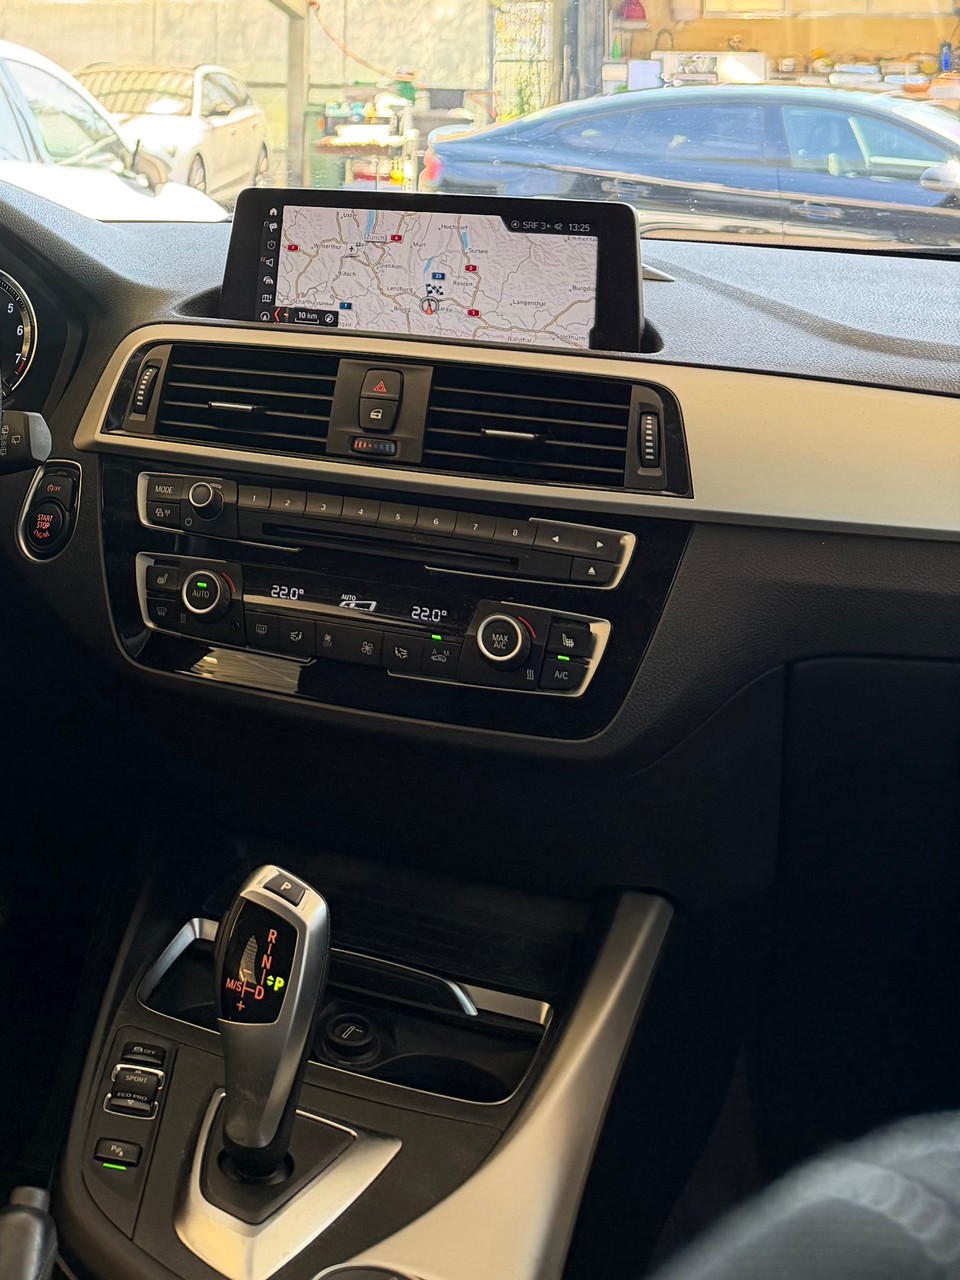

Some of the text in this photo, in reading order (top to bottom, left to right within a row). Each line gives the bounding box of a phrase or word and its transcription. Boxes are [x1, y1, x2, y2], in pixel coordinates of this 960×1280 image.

[523, 221, 551, 230] SRF 3+
[569, 223, 590, 232] 13:25
[387, 285, 413, 293] Lenzburg
[7, 303, 14, 313] 5
[16, 325, 24, 335] 6
[15, 353, 22, 364] 7
[154, 485, 174, 494] MODE
[285, 499, 291, 507] 2
[37, 513, 54, 522] START
[36, 521, 51, 530] STOP
[192, 589, 210, 599] AUTO
[341, 593, 357, 601] AUTO
[492, 633, 509, 642] MAX
[493, 641, 507, 650] A/C
[554, 671, 569, 680] A/C
[280, 881, 292, 891] P
[267, 928, 278, 944] R
[261, 954, 273, 970] N
[225, 977, 243, 992] M/S
[273, 976, 285, 992] P
[254, 985, 265, 1000] D
[125, 1074, 148, 1084] SPORT
[132, 1093, 148, 1101] PRO
